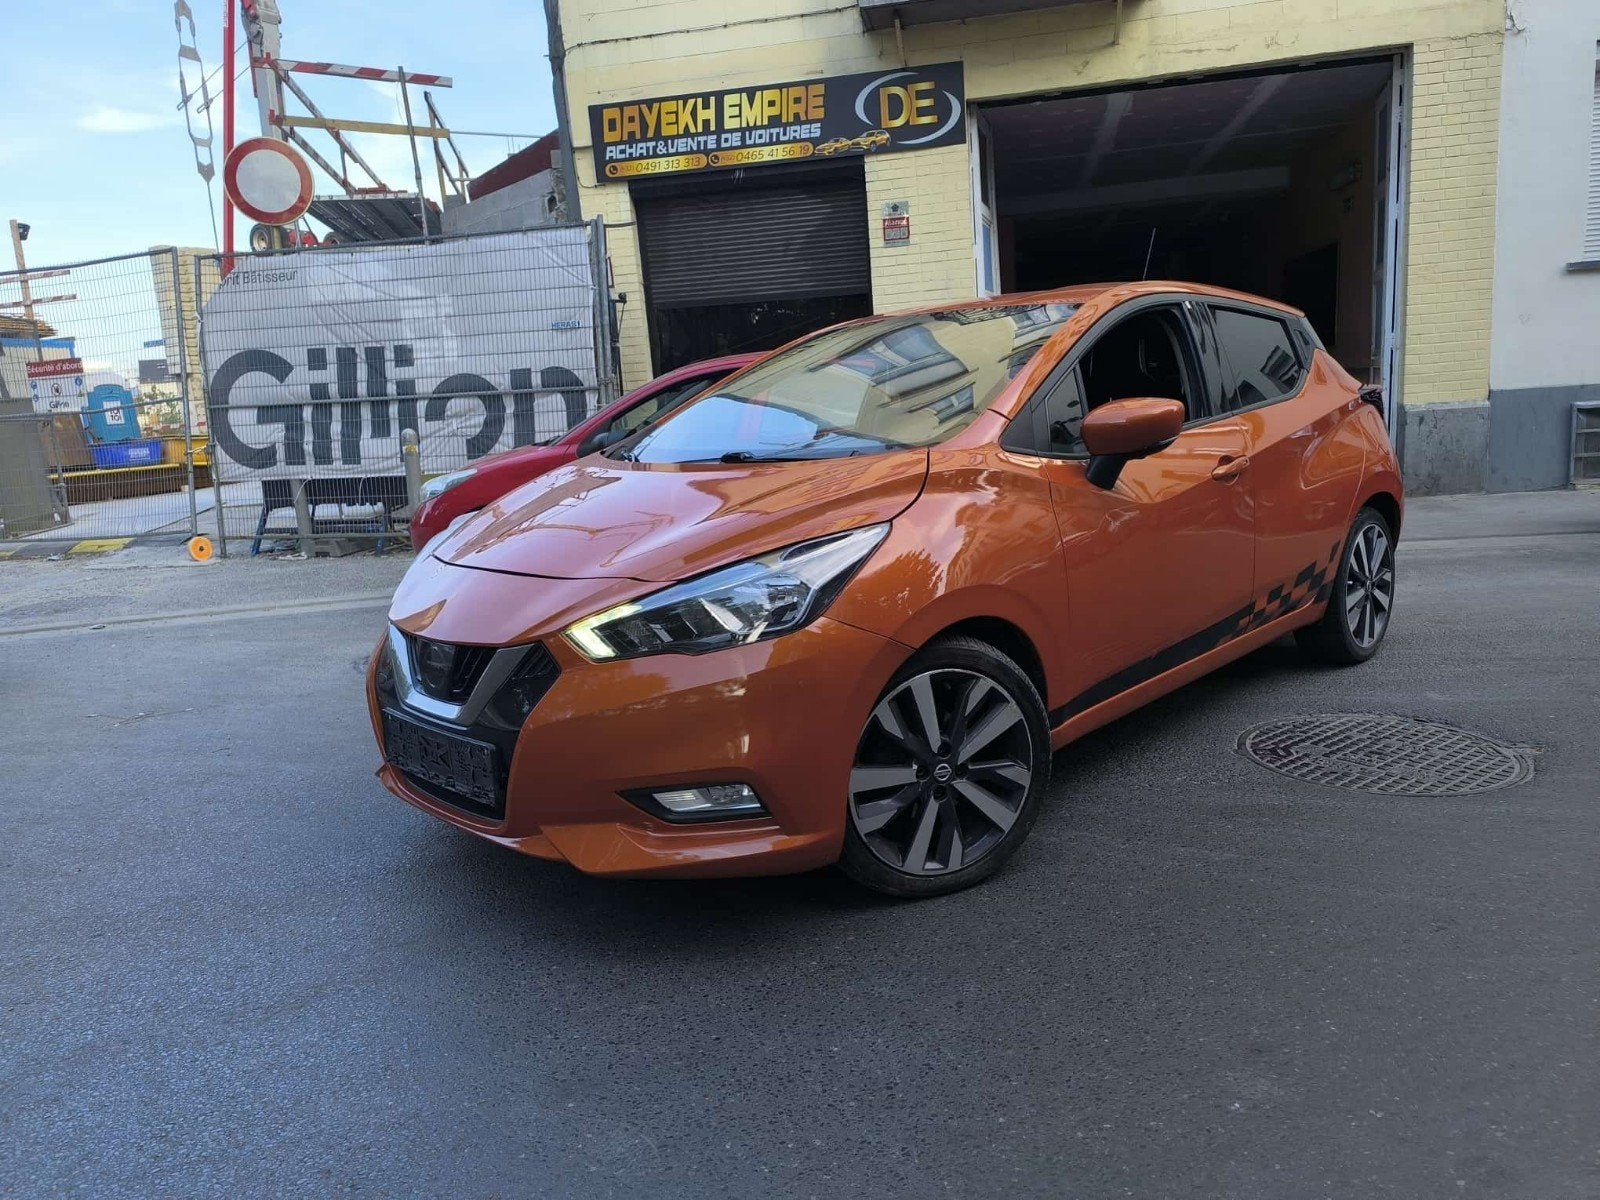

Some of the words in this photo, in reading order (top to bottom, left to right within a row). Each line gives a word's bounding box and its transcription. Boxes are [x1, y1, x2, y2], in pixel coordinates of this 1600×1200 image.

[603, 96, 715, 142] DAYEKH
[724, 83, 825, 130] EMPIRE
[879, 81, 938, 129] DE
[720, 132, 741, 148] DE
[745, 122, 821, 145] VOITURES
[635, 161, 661, 173] 0491
[663, 158, 681, 170] 313
[683, 156, 701, 168] 313
[735, 150, 764, 162] 0465
[767, 148, 779, 158] 41
[781, 146, 796, 156] 56
[242, 270, 298, 285] Bâtisseur
[209, 344, 588, 470] Gillion
